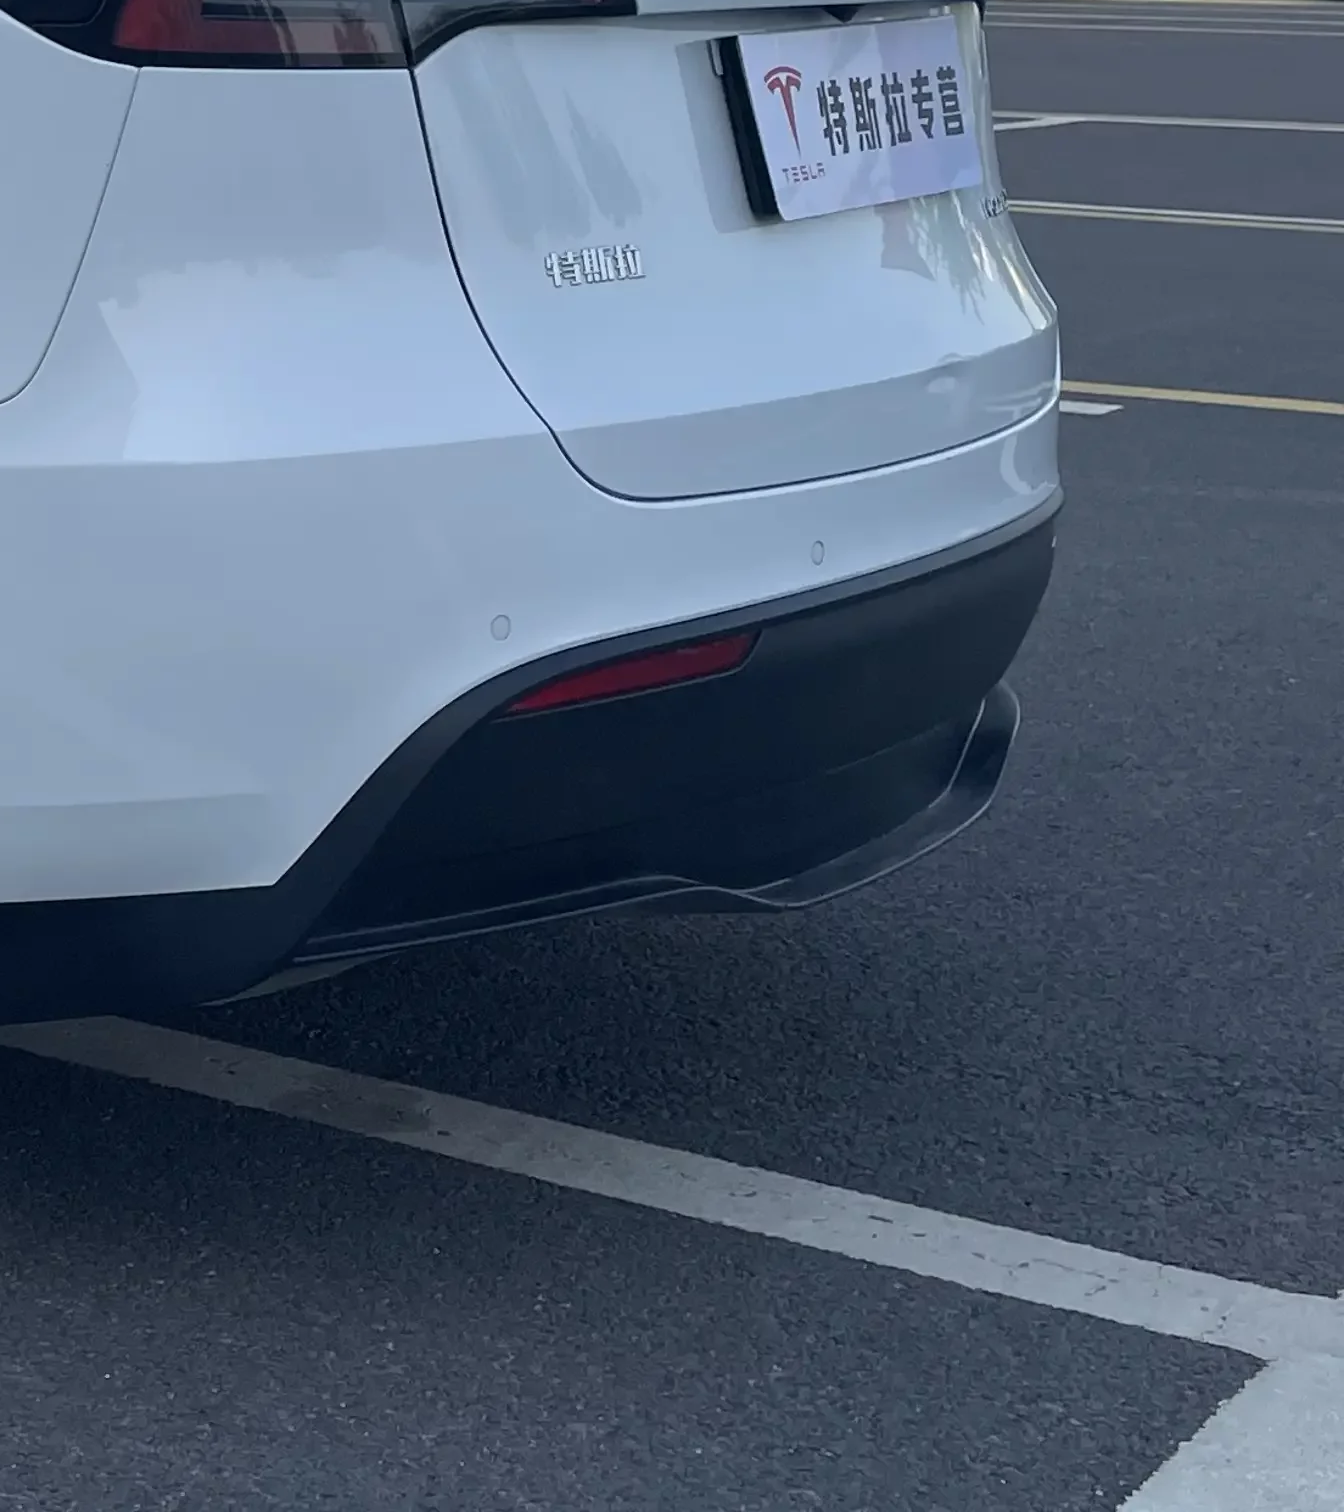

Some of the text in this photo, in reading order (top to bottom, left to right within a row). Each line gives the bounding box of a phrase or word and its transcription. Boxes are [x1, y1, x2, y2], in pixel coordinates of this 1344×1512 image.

[815, 65, 965, 157] 特斯拉专营
[781, 162, 827, 185] TESLA
[544, 244, 647, 288] 特斯拉
